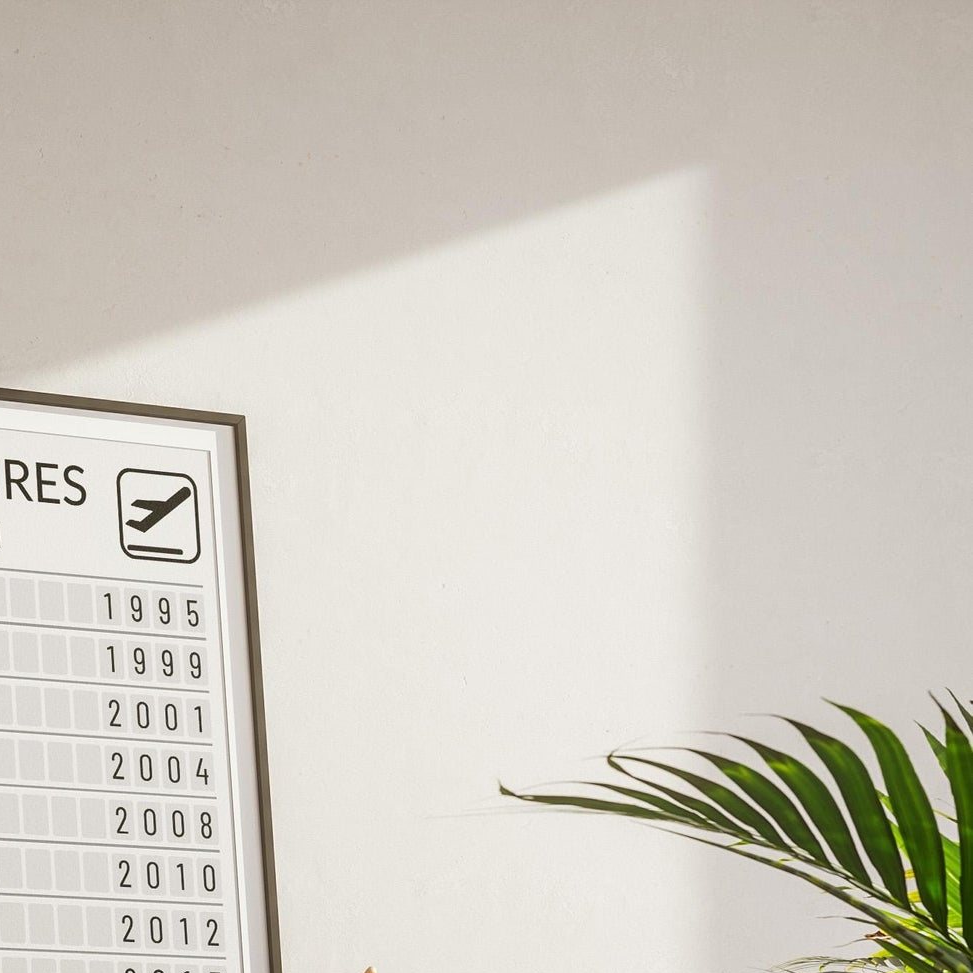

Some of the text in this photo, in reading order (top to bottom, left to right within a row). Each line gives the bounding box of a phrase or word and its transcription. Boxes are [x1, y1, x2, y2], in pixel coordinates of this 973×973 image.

[103, 592, 199, 627] 1995
[106, 645, 202, 679] 1999
[108, 699, 203, 733] 2001
[111, 752, 209, 786] 2004
[115, 806, 213, 839] 2008
[118, 860, 216, 892] 2010
[121, 914, 220, 947] 2012
